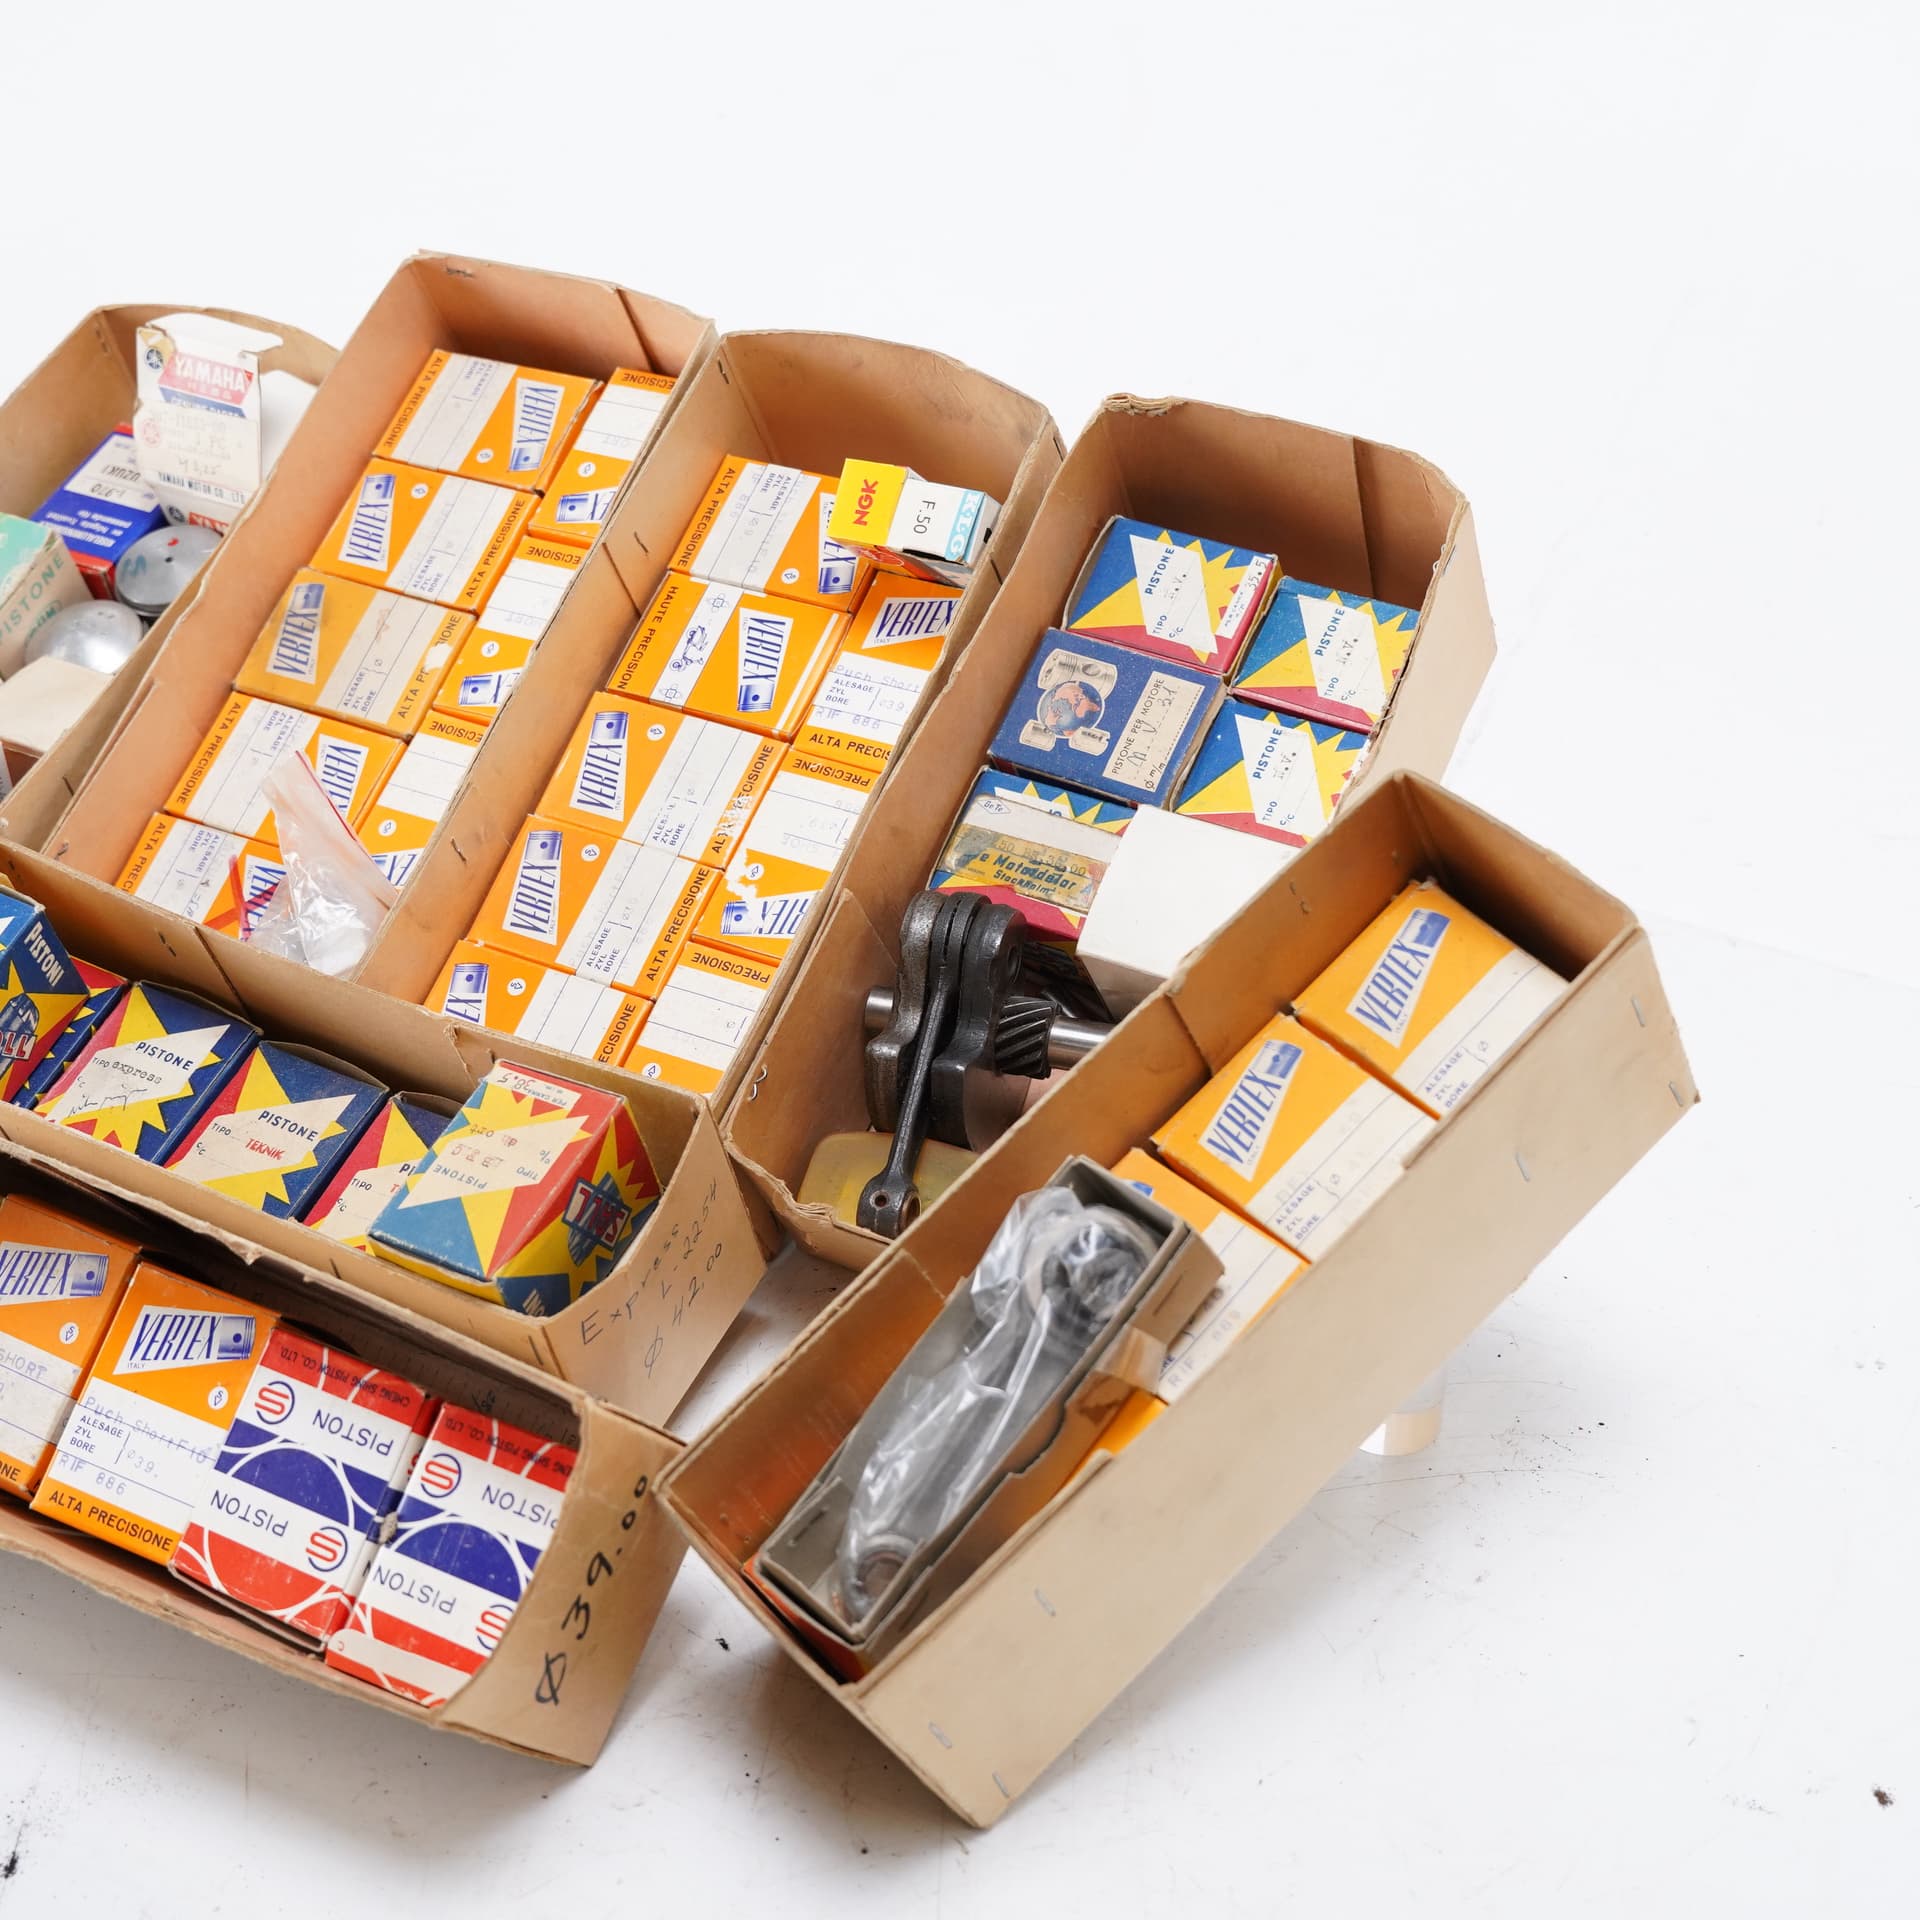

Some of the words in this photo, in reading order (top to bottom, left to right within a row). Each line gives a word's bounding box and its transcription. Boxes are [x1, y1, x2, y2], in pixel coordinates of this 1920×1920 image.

[174, 353, 246, 393] YAMAHA
[425, 356, 443, 386] ALTA
[622, 371, 676, 391] ECISIONE
[383, 384, 428, 450] PRECISIONE
[515, 385, 559, 448] VERTEX
[101, 464, 142, 482] UZUKI
[716, 467, 736, 497] ALTA
[768, 476, 793, 512] ALESAGE
[852, 479, 879, 527] NGK
[346, 501, 389, 563] VERTEX
[466, 569, 486, 598] ALTA
[485, 498, 525, 568] PRECISIONE
[676, 496, 721, 568] PRECISIONE
[526, 545, 582, 565] ECISIONE
[1143, 547, 1176, 596] PISTONE
[1, 554, 65, 638] ISTONE
[653, 585, 680, 623] HAUTE
[875, 600, 958, 638] VERTEX
[1152, 614, 1168, 635] TIPO
[1314, 607, 1346, 657] PISTONE
[272, 609, 319, 676] VERTEX
[616, 627, 657, 690] PRECISION
[741, 616, 787, 683] VERTEX
[342, 670, 366, 707] ALESAGE
[361, 689, 377, 713] BORE
[397, 686, 420, 719] ALTA
[825, 694, 850, 706] BORE
[828, 686, 846, 696] ZYL
[833, 678, 875, 694] ALESAGE
[1324, 676, 1340, 698] TIPO
[221, 701, 242, 731] ALTA
[351, 697, 363, 712] ZYL
[429, 720, 484, 743] ECISIONE
[1111, 735, 1136, 775] PISTONE
[1130, 717, 1146, 735] PER
[1140, 678, 1166, 716] MOTORE
[809, 733, 841, 748] ALTA
[846, 740, 892, 761] PRECIS
[1252, 727, 1283, 780] PISTONE
[176, 734, 223, 805] PRECISIONE
[576, 740, 624, 812] VERTEX
[791, 758, 872, 787] PRECISIONE
[1261, 800, 1279, 822] TIPO
[144, 821, 168, 852] ALTA
[660, 827, 673, 845] ZYL
[669, 822, 686, 847] BORE
[508, 864, 560, 937] VERTEX
[645, 949, 669, 982] ALTA
[664, 867, 710, 944] PRECISIONE
[23, 921, 65, 988] PISTONI
[585, 926, 611, 968] ALESAGE
[594, 953, 609, 971] ZYL
[603, 947, 621, 974] BORE
[691, 950, 772, 984] PRECISIONE
[1355, 937, 1430, 1034] VERTEX
[598, 1003, 637, 1063] ECISIONE
[91, 1056, 112, 1069] TIPO
[134, 1041, 195, 1072] PISTONE
[1424, 1049, 1465, 1093] ALESAGE
[1434, 1082, 1453, 1101] ZYL
[1444, 1080, 1469, 1109] BORE
[257, 1109, 320, 1143] PISTONE
[1206, 1068, 1283, 1165] VERTEX
[209, 1122, 233, 1137] TIPO
[244, 1137, 287, 1162] TEKNIK
[350, 1178, 373, 1192] TIPO
[432, 1163, 489, 1190] PISTONE
[515, 1165, 540, 1181] TIPO
[1274, 1183, 1316, 1226] ALESAGE
[1284, 1213, 1303, 1233] ZYL
[1294, 1213, 1321, 1241] BORE
[0, 1250, 76, 1297] VERTEX
[128, 1313, 222, 1362] VERTEX
[126, 1362, 147, 1370] ITALY
[79, 1413, 125, 1440] ALESAGE
[85, 1395, 125, 1425] Puch
[69, 1436, 97, 1455] BORE
[74, 1424, 94, 1439] ZYL
[311, 1407, 396, 1458] PISTON
[48, 1489, 84, 1514] ALTA
[86, 1504, 175, 1553] PRECISIONE
[210, 1488, 289, 1538] PISTON
[371, 1565, 457, 1615] PISTON
